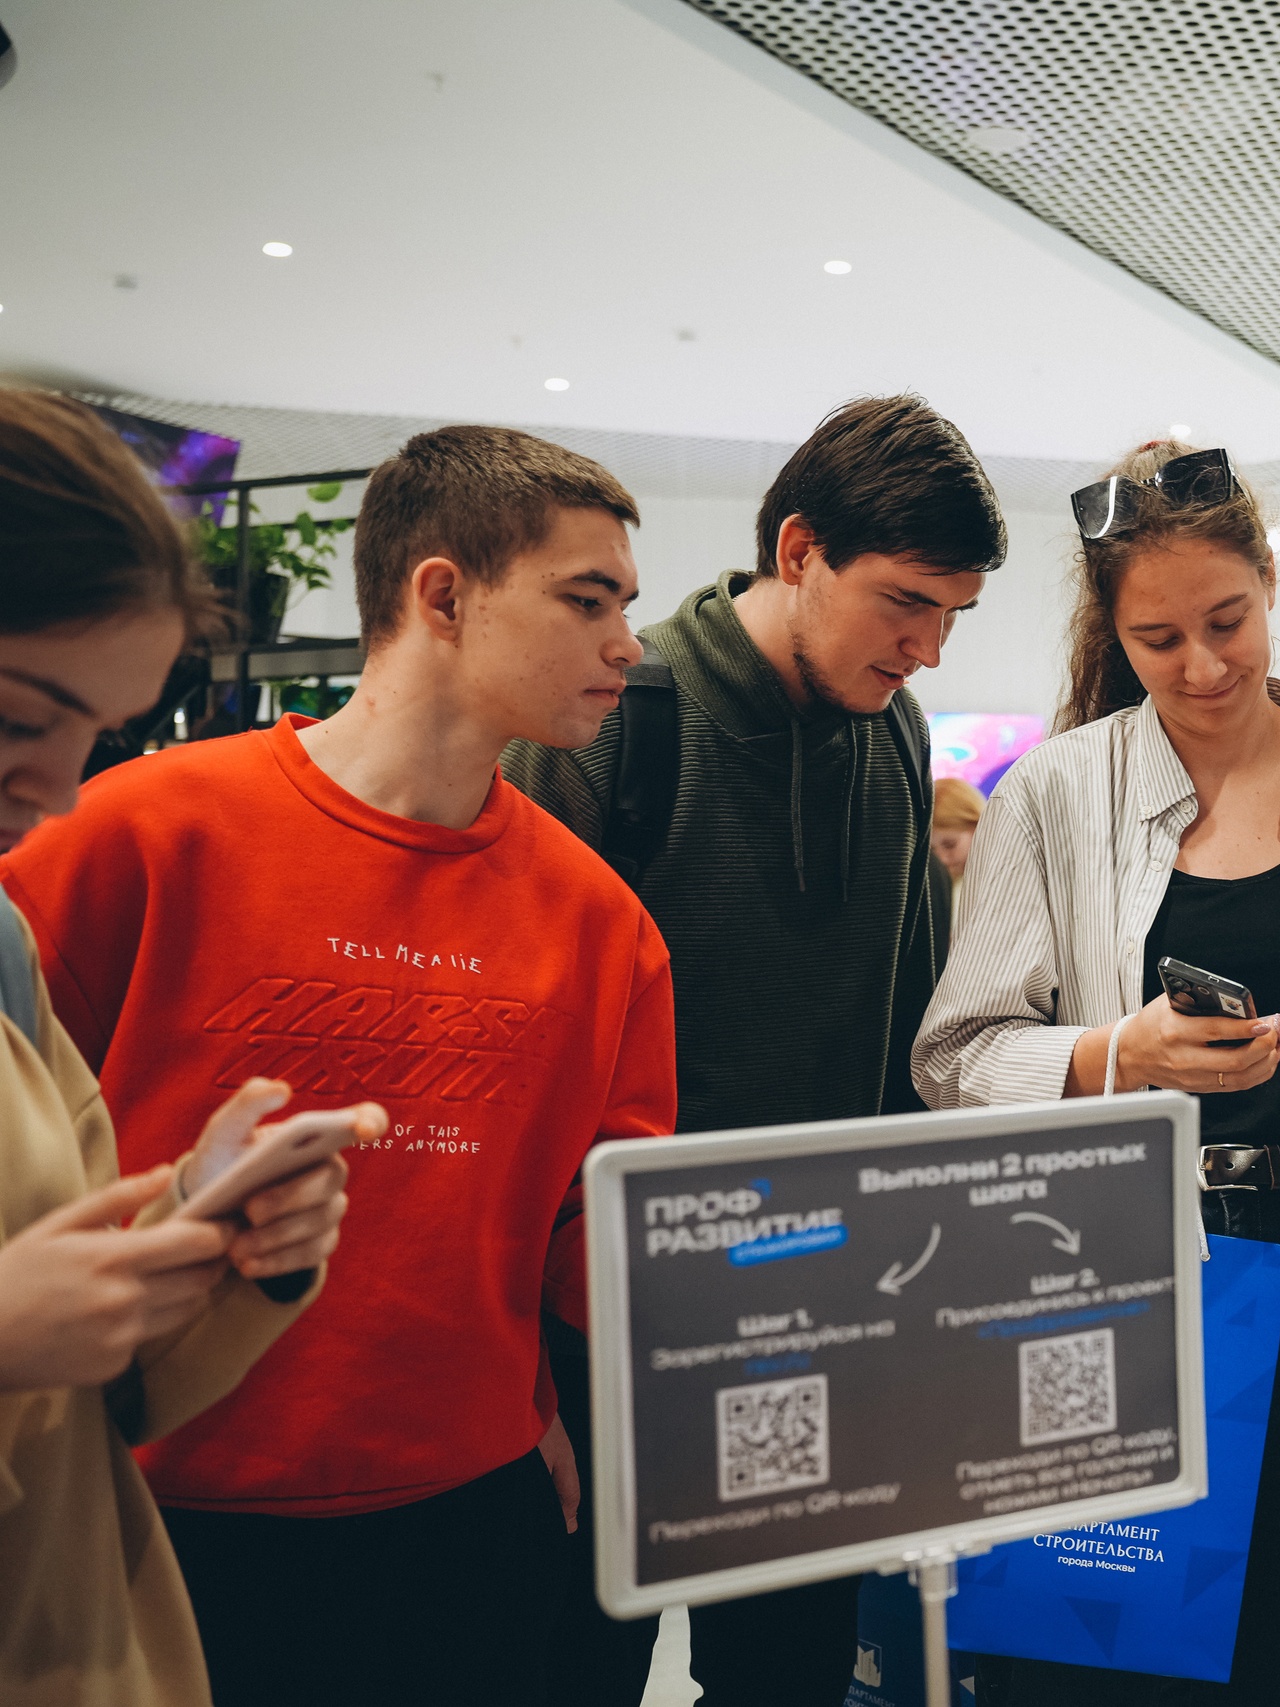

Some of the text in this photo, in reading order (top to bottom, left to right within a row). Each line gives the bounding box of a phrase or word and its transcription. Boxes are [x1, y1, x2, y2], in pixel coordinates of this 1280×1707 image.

[327, 937, 385, 960] TELL
[394, 1124, 460, 1138] OF THIS
[405, 1140, 481, 1154] ANYMORE
[860, 1143, 1146, 1192] Выполни 2 простых
[969, 1180, 1048, 1205] шага
[646, 1188, 762, 1225] ПРОФ
[647, 1209, 843, 1258] РАЗВИТИЕ
[1061, 1521, 1160, 1542] ПАРТАМЕНТ
[1033, 1533, 1165, 1563] СТРОИТЕЛЬСТВА
[1057, 1555, 1136, 1573] города Москвы
